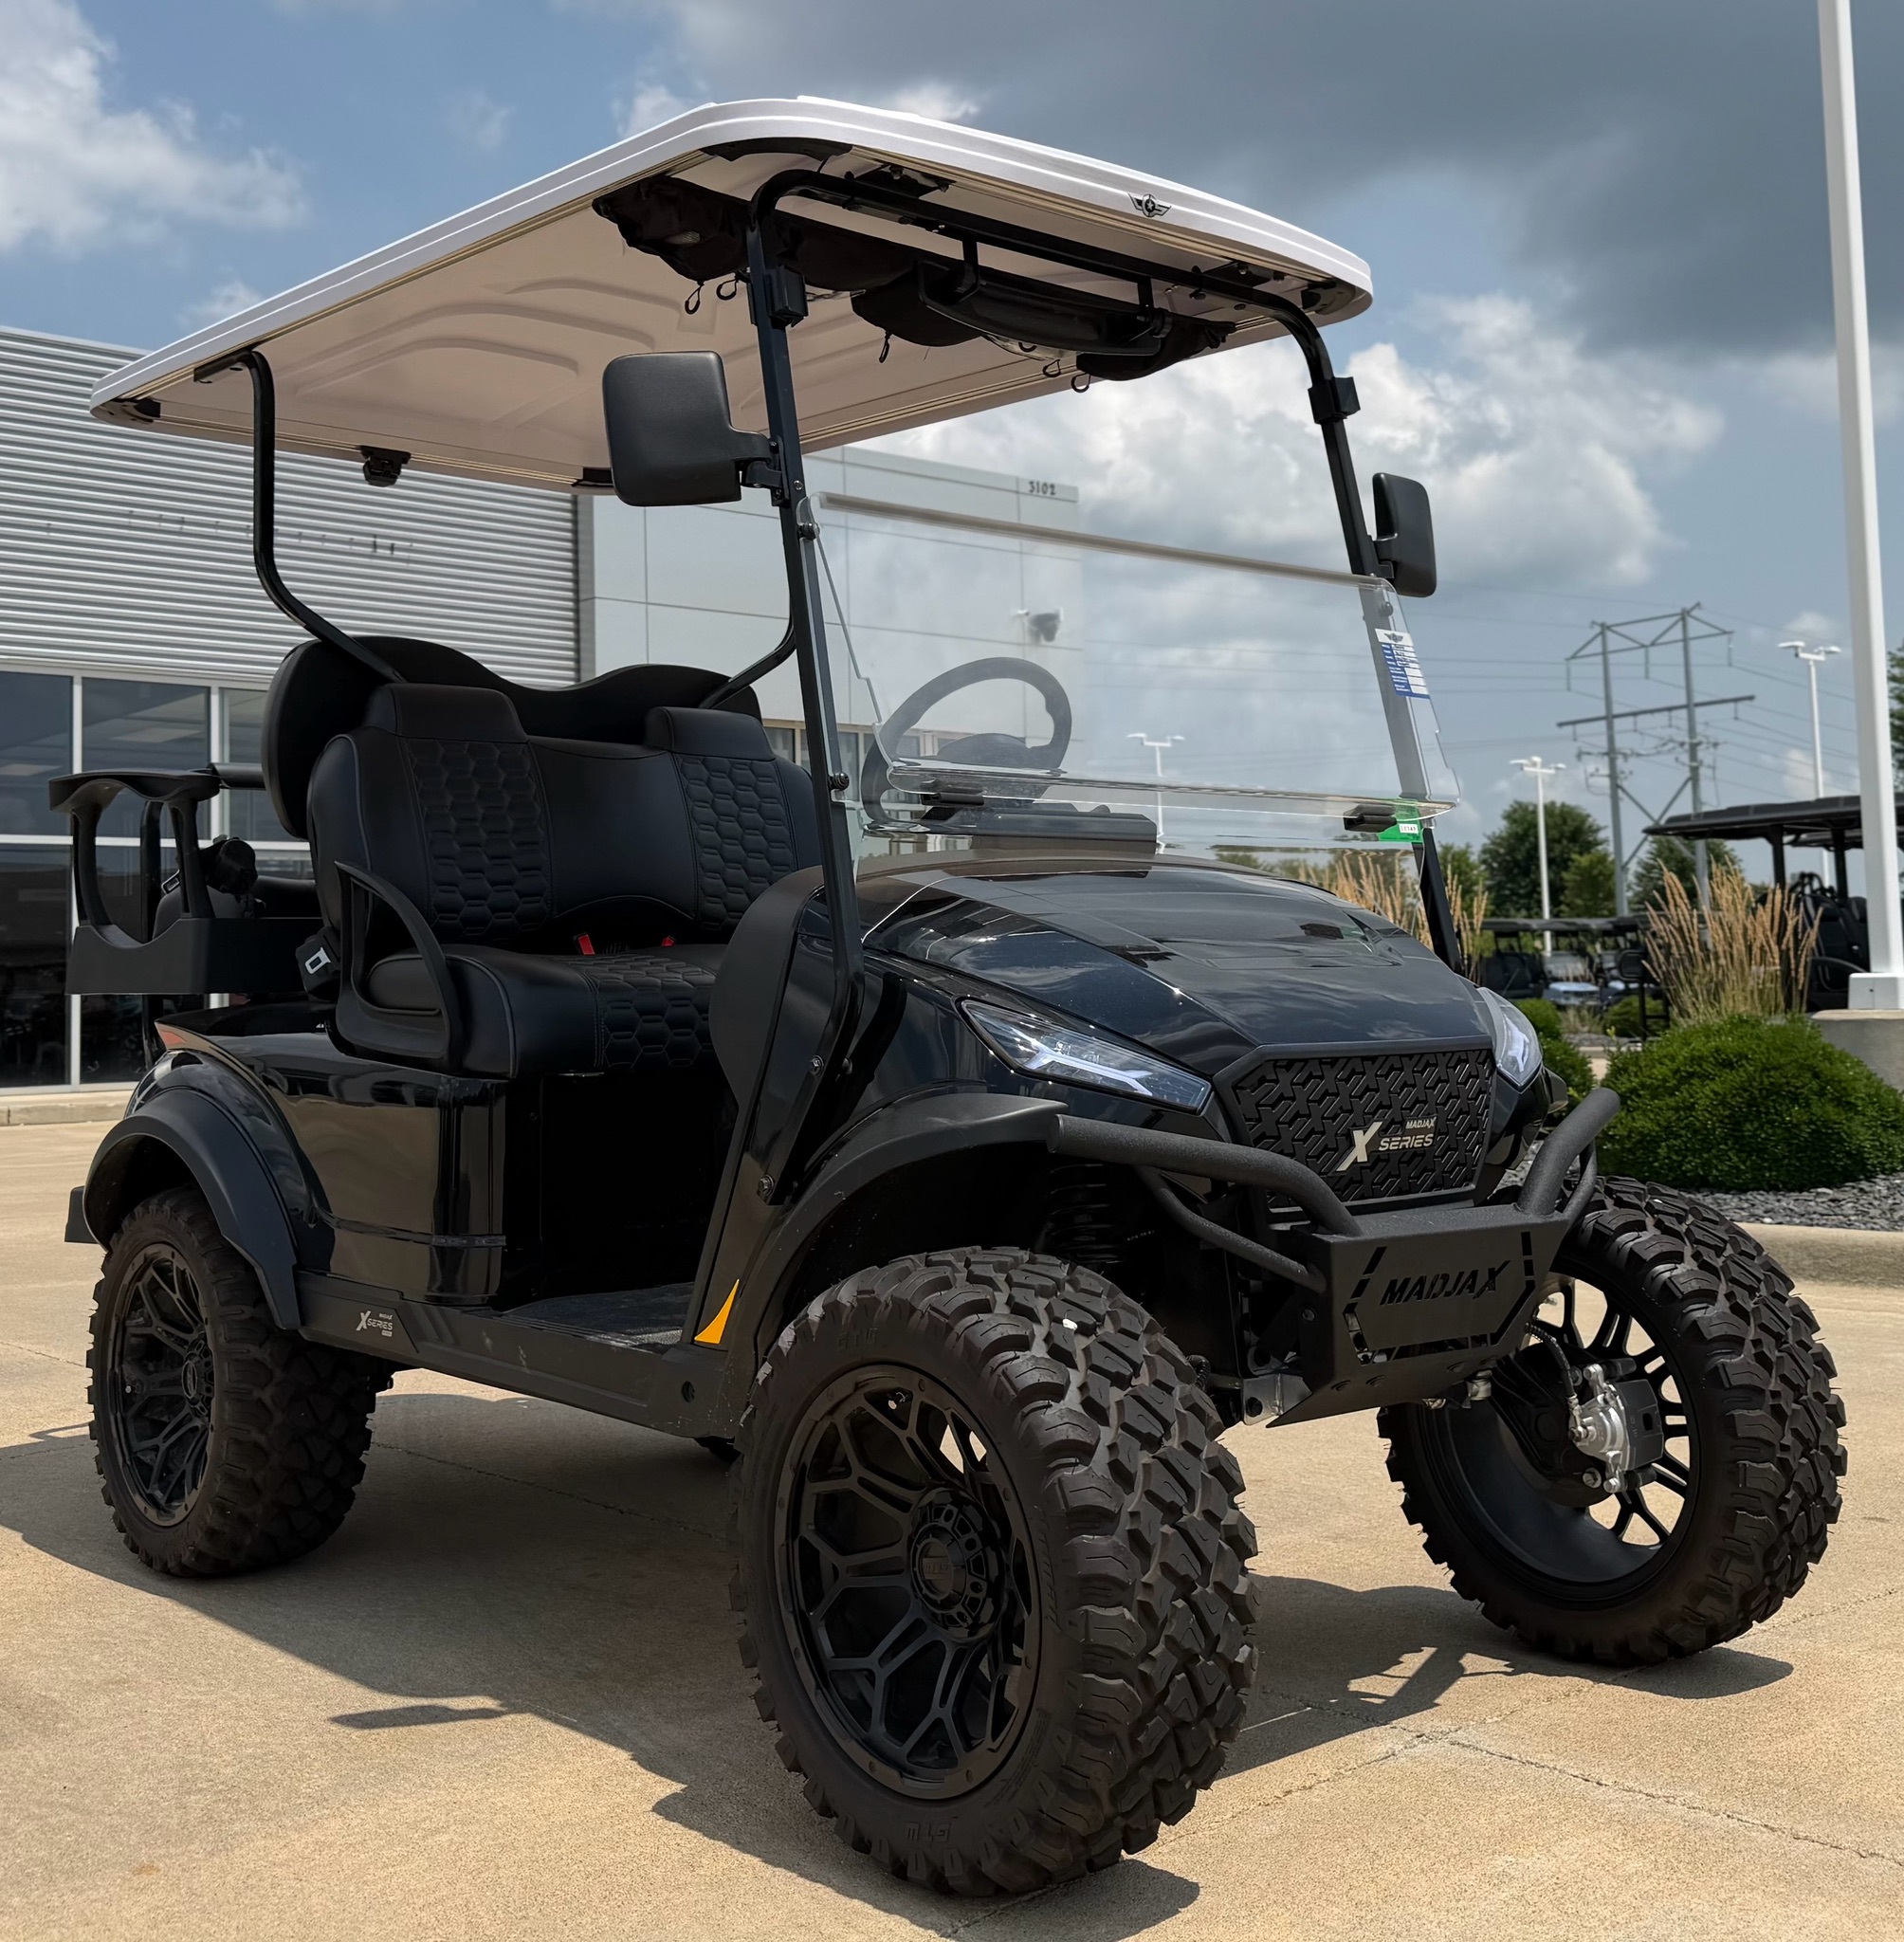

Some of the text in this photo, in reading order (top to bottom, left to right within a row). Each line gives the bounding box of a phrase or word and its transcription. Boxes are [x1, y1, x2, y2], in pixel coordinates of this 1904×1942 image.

[1029, 481, 1056, 495] 3102
[1406, 1117, 1437, 1129] MADJAX
[1336, 1121, 1434, 1172] X SERIES
[1380, 1260, 1510, 1306] MADJAX
[356, 1310, 372, 1331] X
[367, 1317, 394, 1331] SERIES
